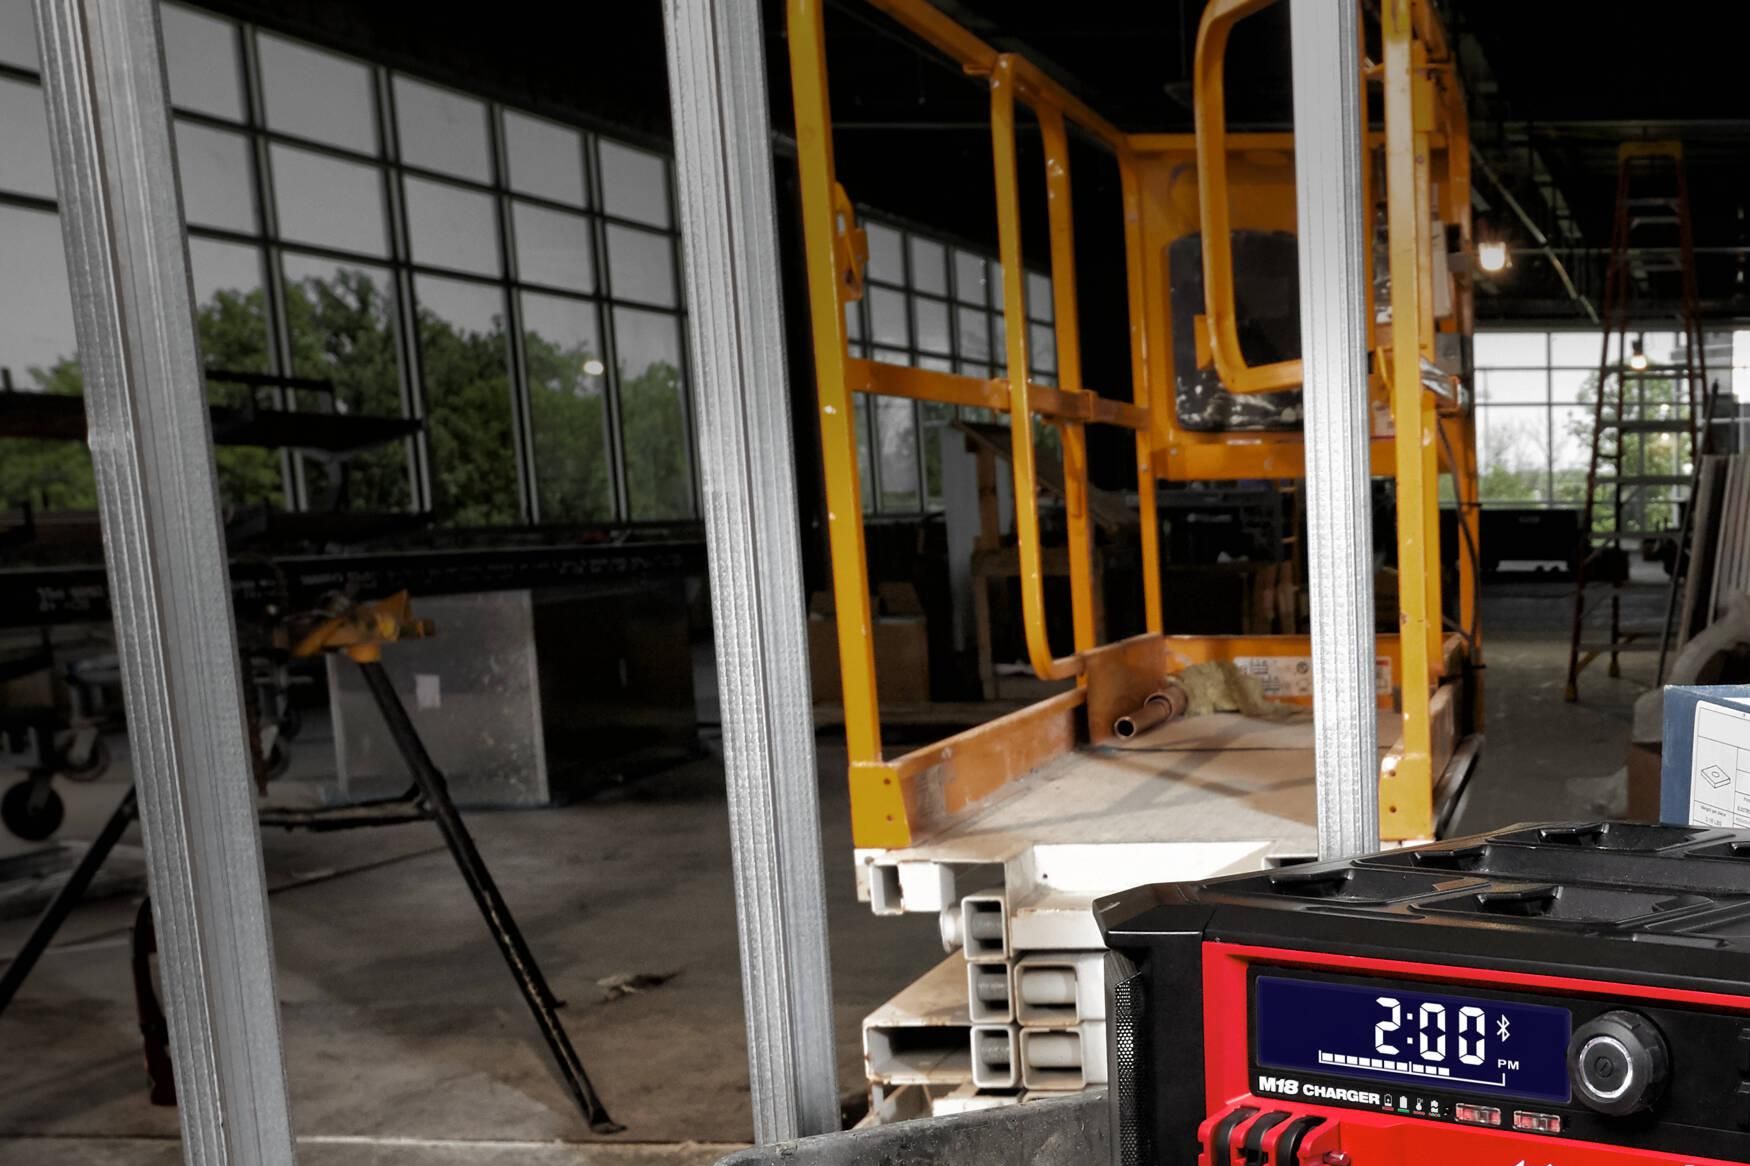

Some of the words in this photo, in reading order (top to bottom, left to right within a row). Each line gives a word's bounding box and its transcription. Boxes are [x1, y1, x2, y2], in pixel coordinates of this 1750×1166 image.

[1374, 996, 1486, 1066] 2:00
[1497, 1058, 1520, 1071] PM
[1258, 1075, 1299, 1097] M18
[1302, 1083, 1381, 1106] CHARGER
